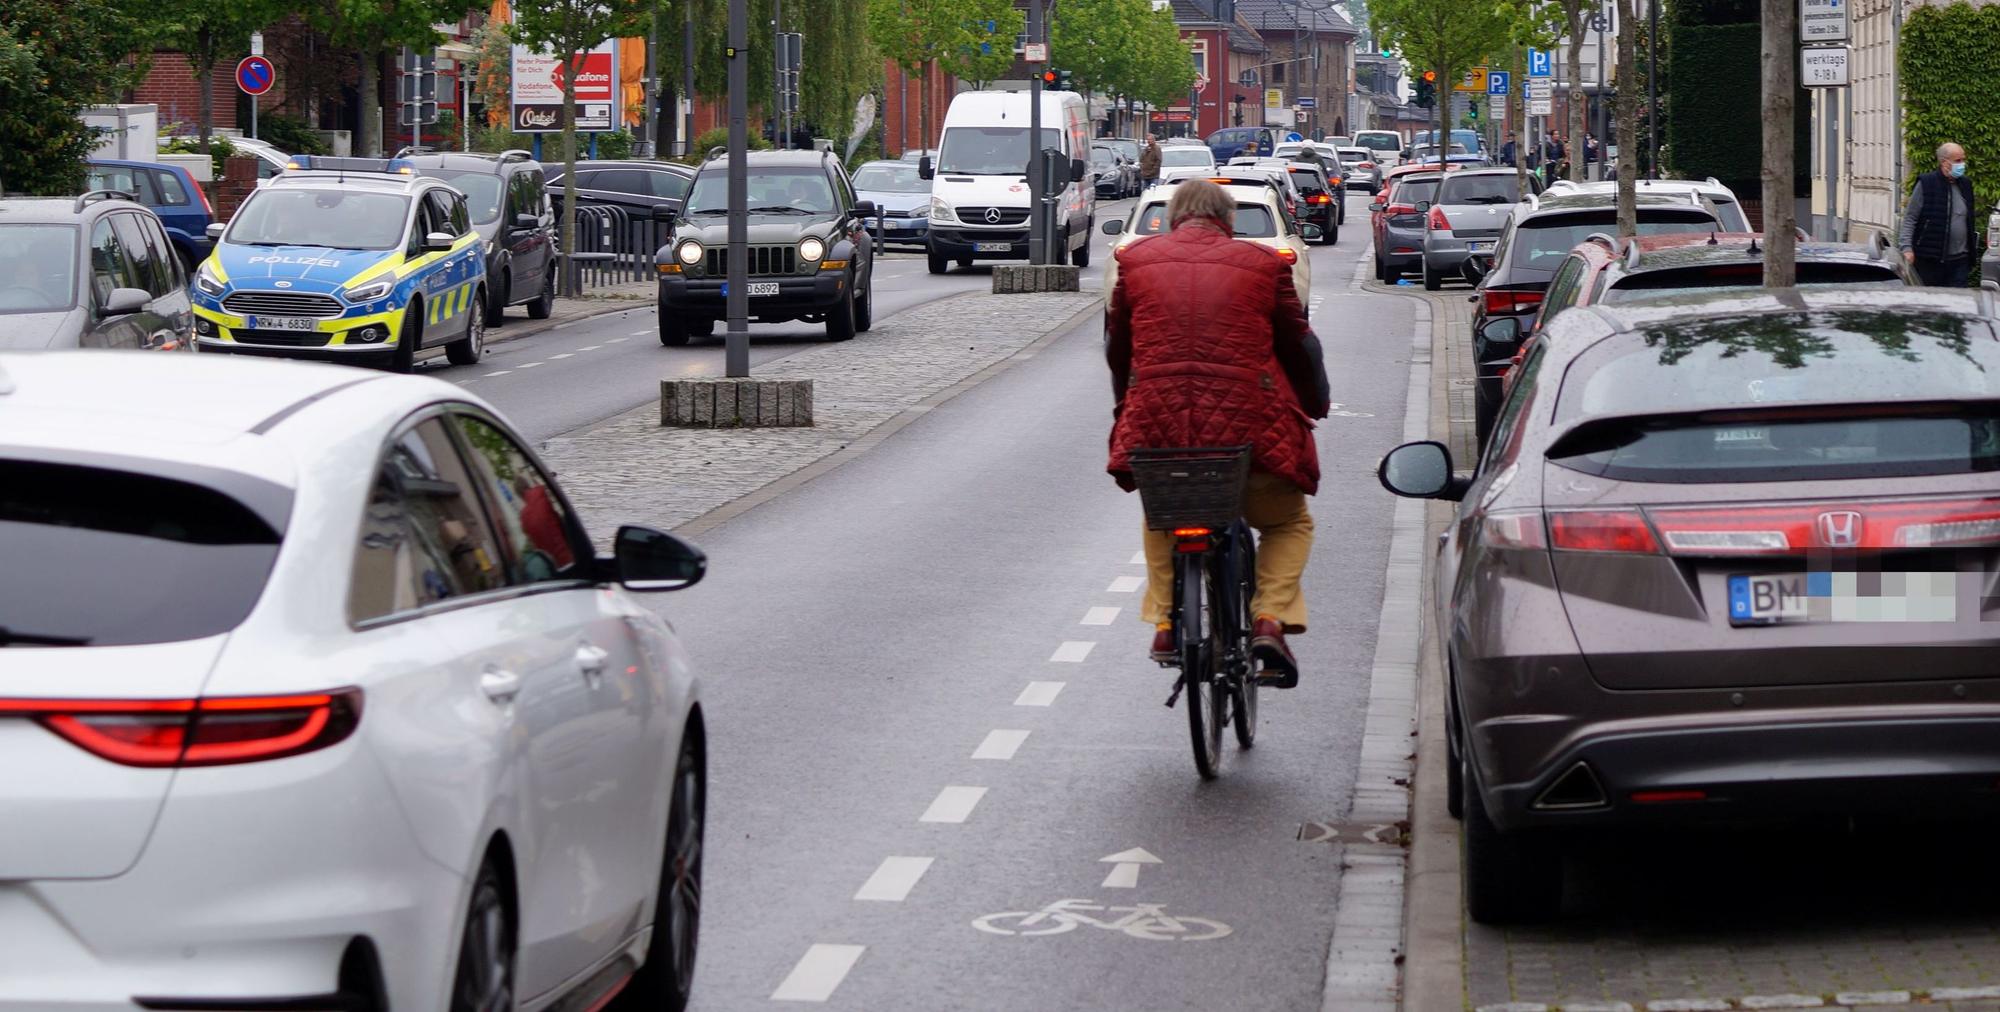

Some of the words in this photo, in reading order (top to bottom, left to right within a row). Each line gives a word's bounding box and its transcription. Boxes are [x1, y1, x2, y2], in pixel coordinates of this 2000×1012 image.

[1806, 54, 1845, 67] werktags
[517, 82, 553, 90] Vodafone
[248, 256, 340, 267] POLIZEI
[754, 284, 778, 293] 6892
[256, 318, 273, 326] NRW
[287, 320, 312, 329] 6830
[1753, 579, 1800, 612] BM
